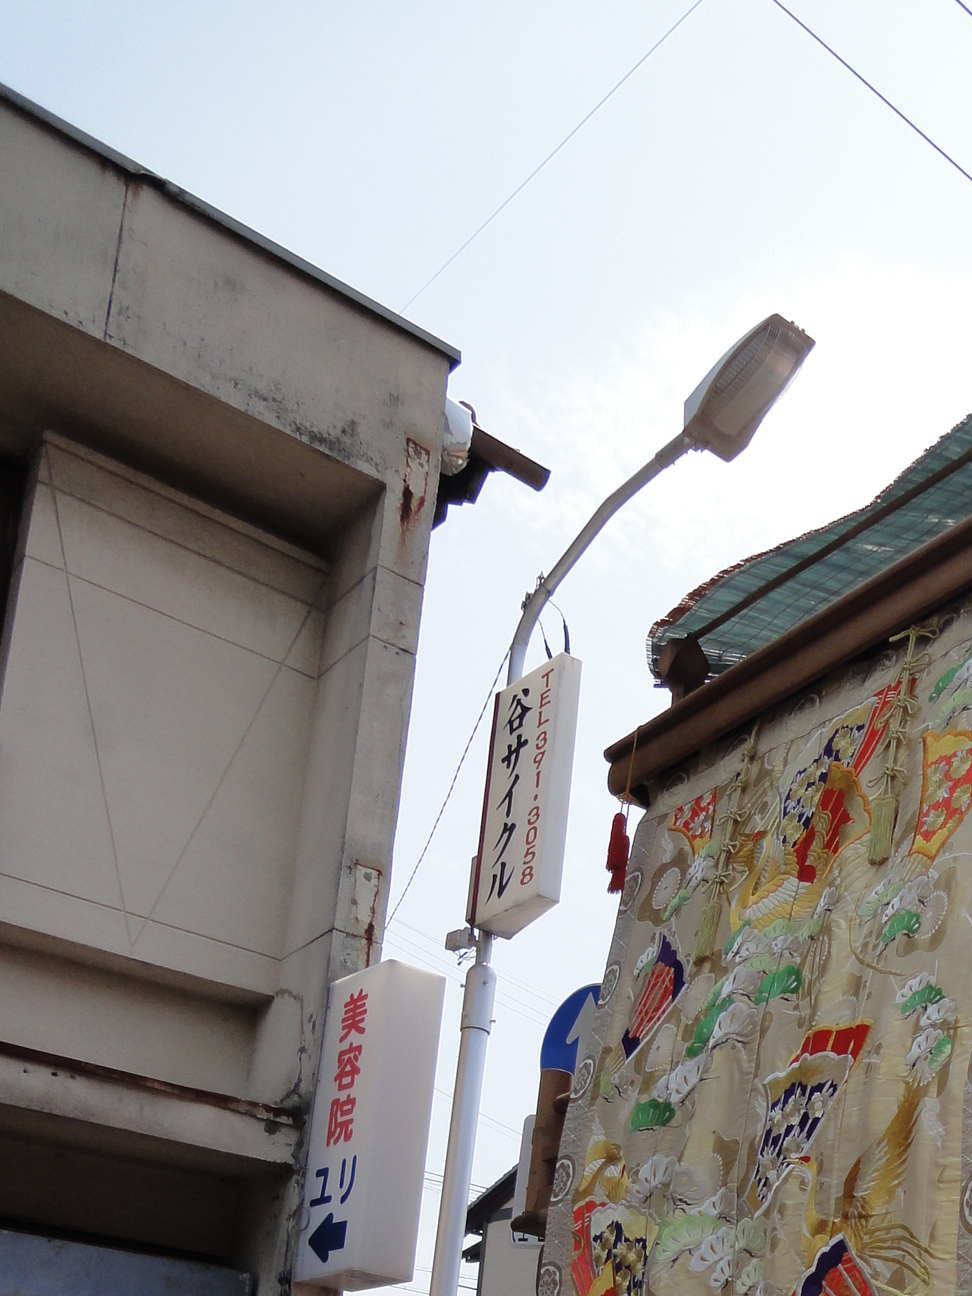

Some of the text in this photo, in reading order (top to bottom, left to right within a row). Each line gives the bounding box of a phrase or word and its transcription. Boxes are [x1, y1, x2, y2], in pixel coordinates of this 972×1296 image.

[484, 687, 534, 906] 谷サイクル
[325, 987, 369, 1148] 美容院
[309, 1154, 358, 1207] ユリ
